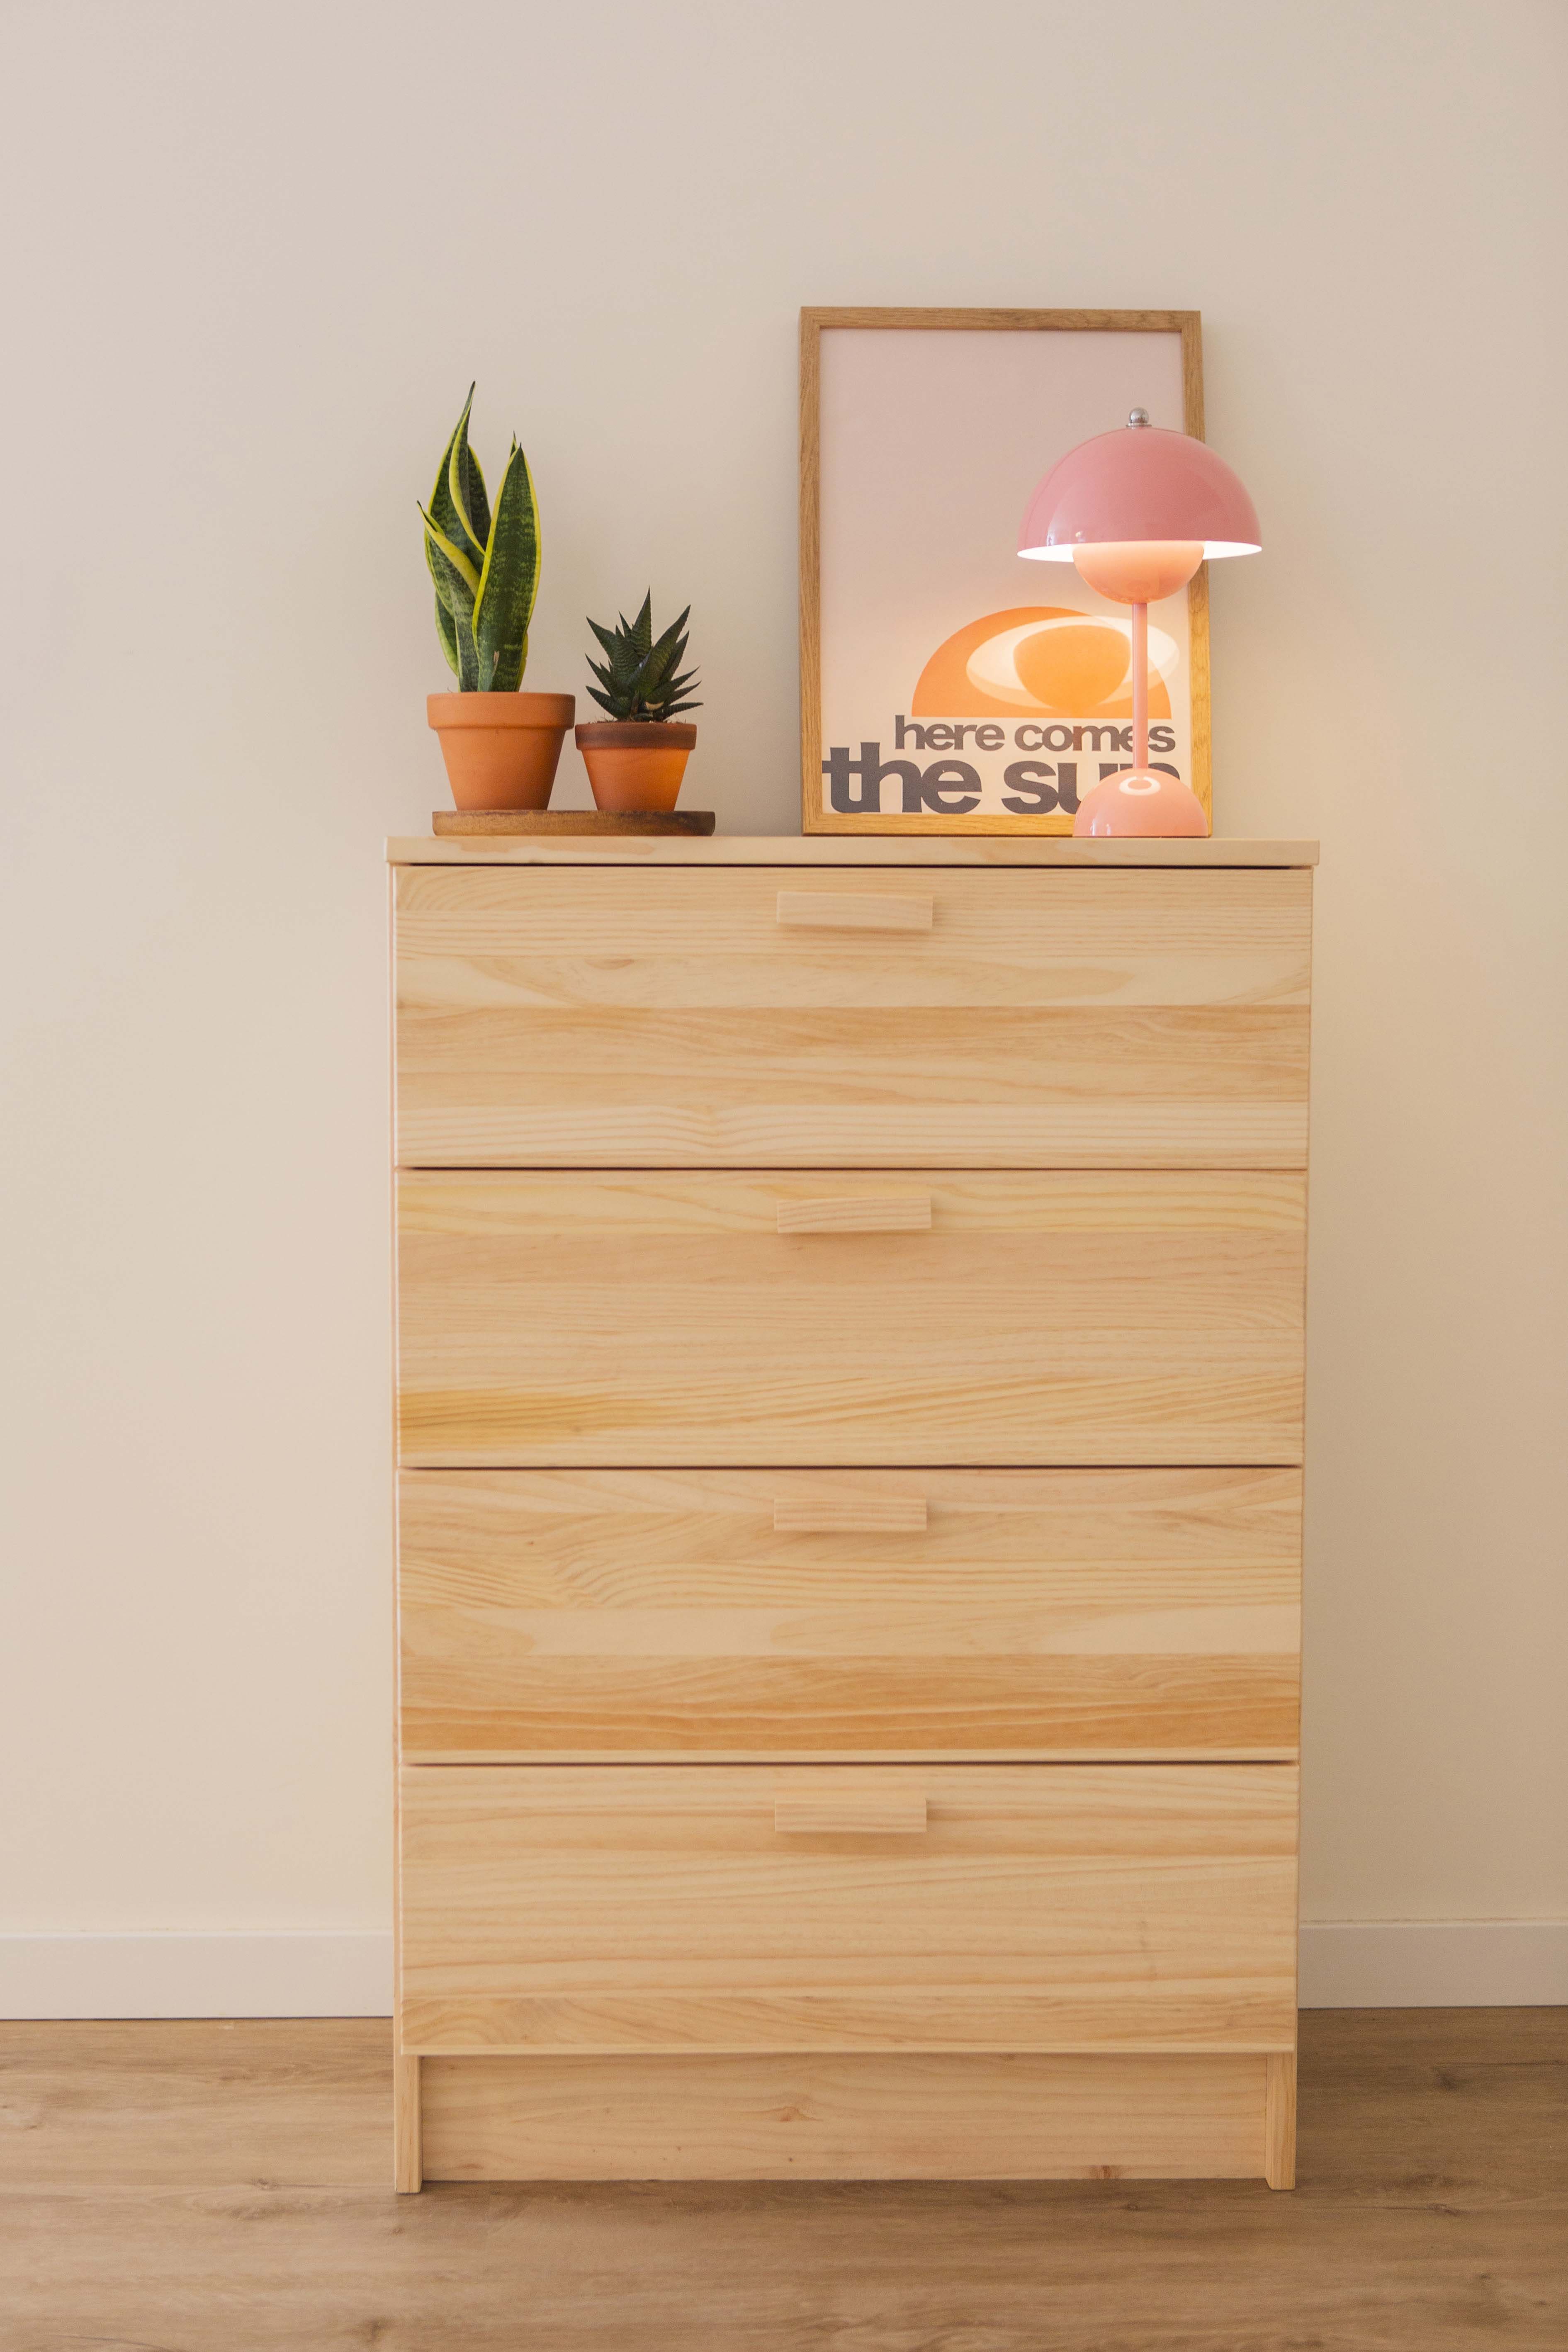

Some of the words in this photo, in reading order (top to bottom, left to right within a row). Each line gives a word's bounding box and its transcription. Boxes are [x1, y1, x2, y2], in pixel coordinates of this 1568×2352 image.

[895, 715, 1005, 751] here
[1014, 724, 1176, 752] comes
[822, 742, 982, 814] the
[1001, 761, 1180, 814] su
